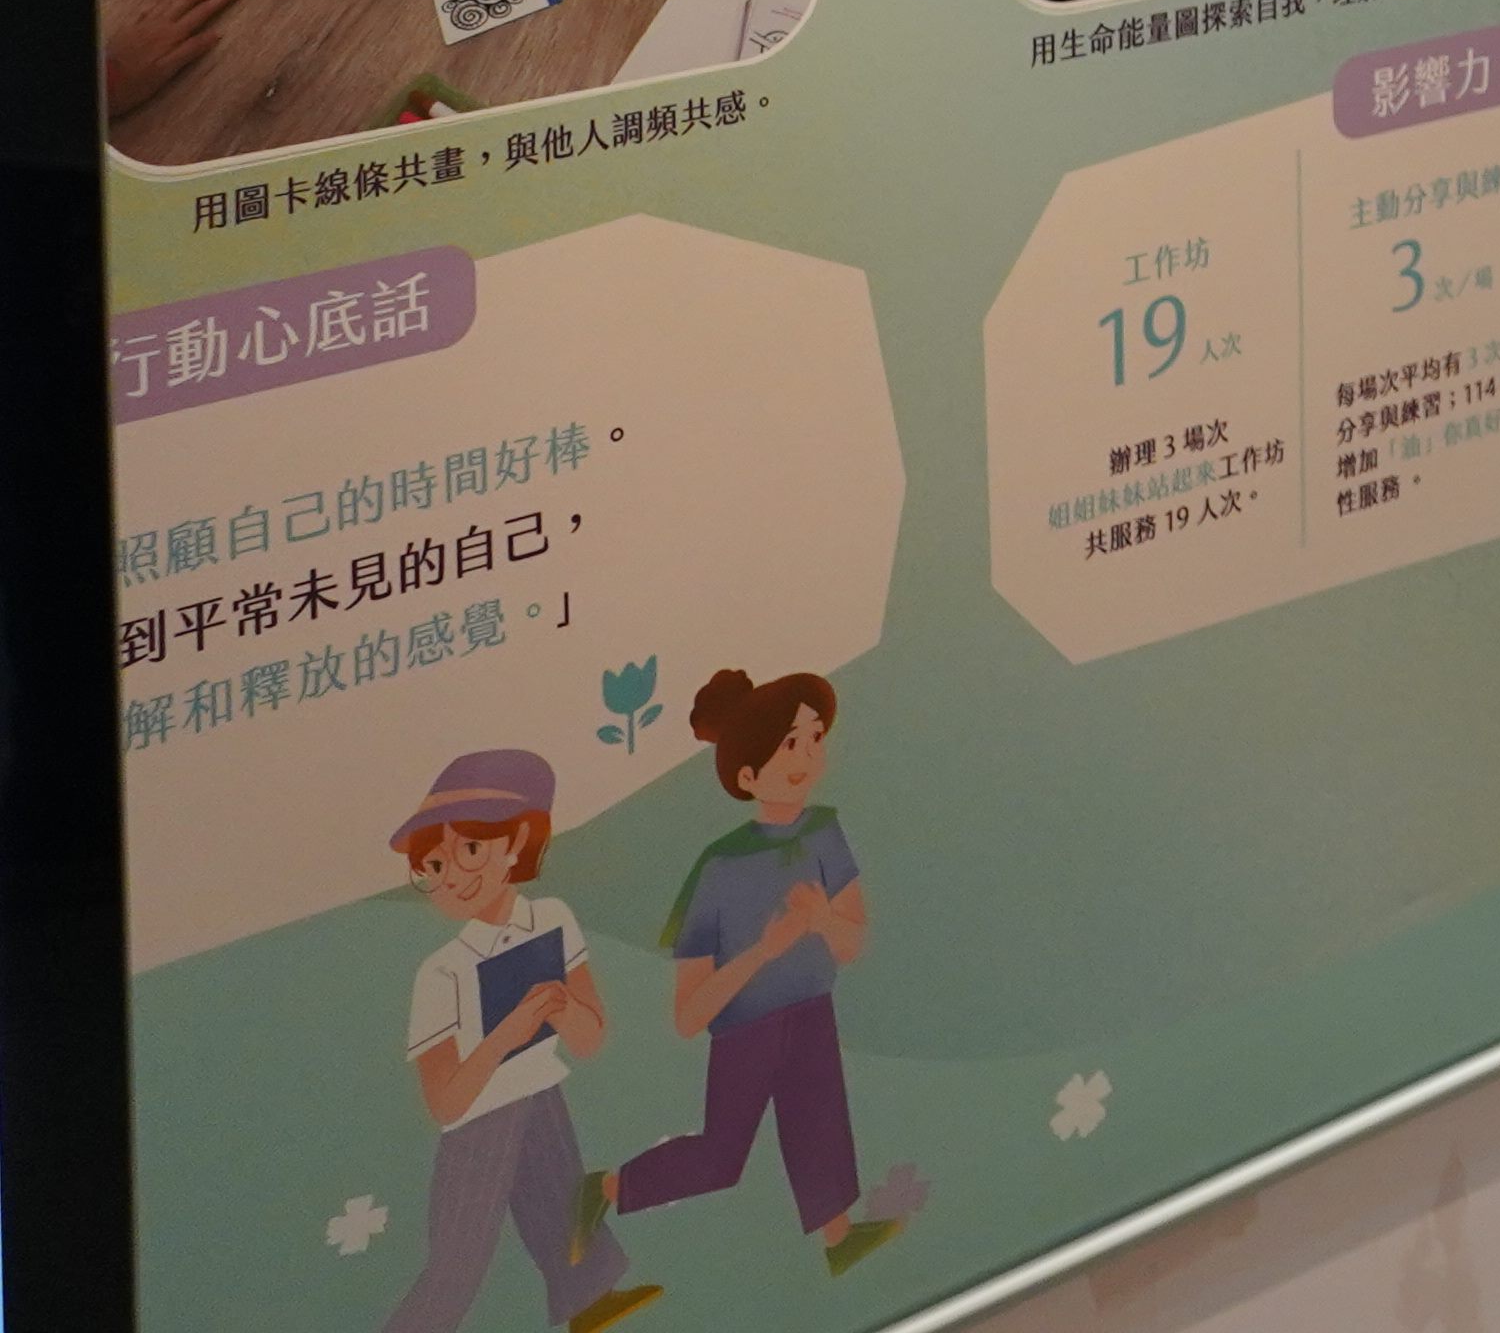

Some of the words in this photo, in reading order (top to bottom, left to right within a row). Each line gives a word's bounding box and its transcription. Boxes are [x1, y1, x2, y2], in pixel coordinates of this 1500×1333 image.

[1371, 47, 1490, 119] 影響力
[192, 89, 772, 234] 用圖卡線條共畫，與他人調頻共感。
[1122, 236, 1210, 286] 工作坊
[1391, 238, 1425, 313] 3
[111, 272, 431, 399] 行動心底話
[1099, 294, 1187, 386] 19
[1199, 331, 1242, 365] 人次
[1336, 350, 1462, 408] 每場次平均有
[1108, 438, 1157, 477] 辦理
[1164, 435, 1177, 460] 3
[1183, 417, 1230, 452] 場次
[117, 421, 626, 588] 照顧自己的時間好棒。
[1084, 514, 1157, 561] 共服務
[1164, 505, 1190, 533] 19
[1197, 489, 1259, 525] 人次。
[121, 508, 585, 670] 到平常未見的自己，
